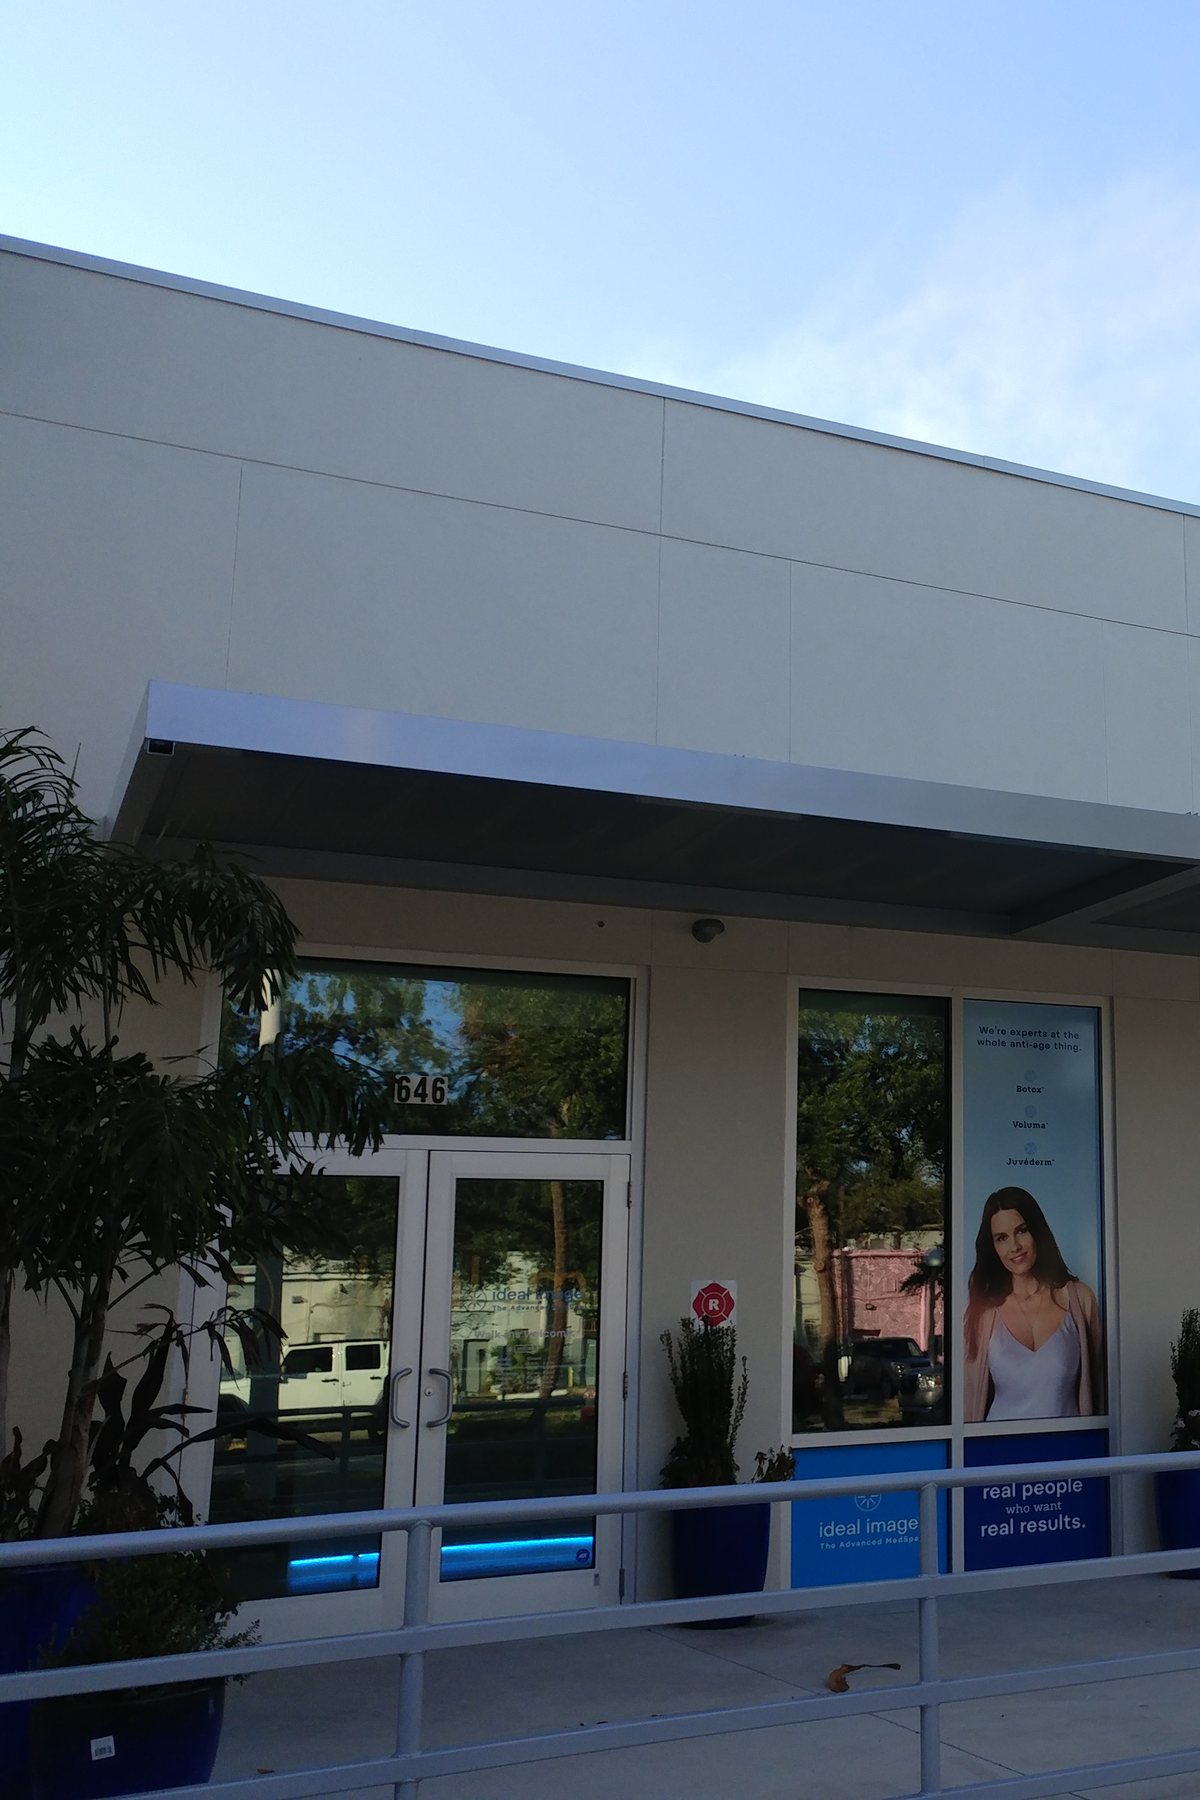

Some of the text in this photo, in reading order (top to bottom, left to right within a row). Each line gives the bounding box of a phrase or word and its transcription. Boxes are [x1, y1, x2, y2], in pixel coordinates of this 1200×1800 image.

[979, 1026, 1080, 1040] We're experts at the
[977, 1039, 1082, 1053] whole anti-age thing.
[397, 1076, 446, 1104] 646
[708, 1299, 720, 1311] R
[983, 1478, 1083, 1501] real people
[1006, 1501, 1062, 1514] who want
[819, 1518, 919, 1538] ideal image
[981, 1514, 1086, 1538] real results.
[820, 1542, 836, 1550] The
[839, 1538, 883, 1548] Advanced
